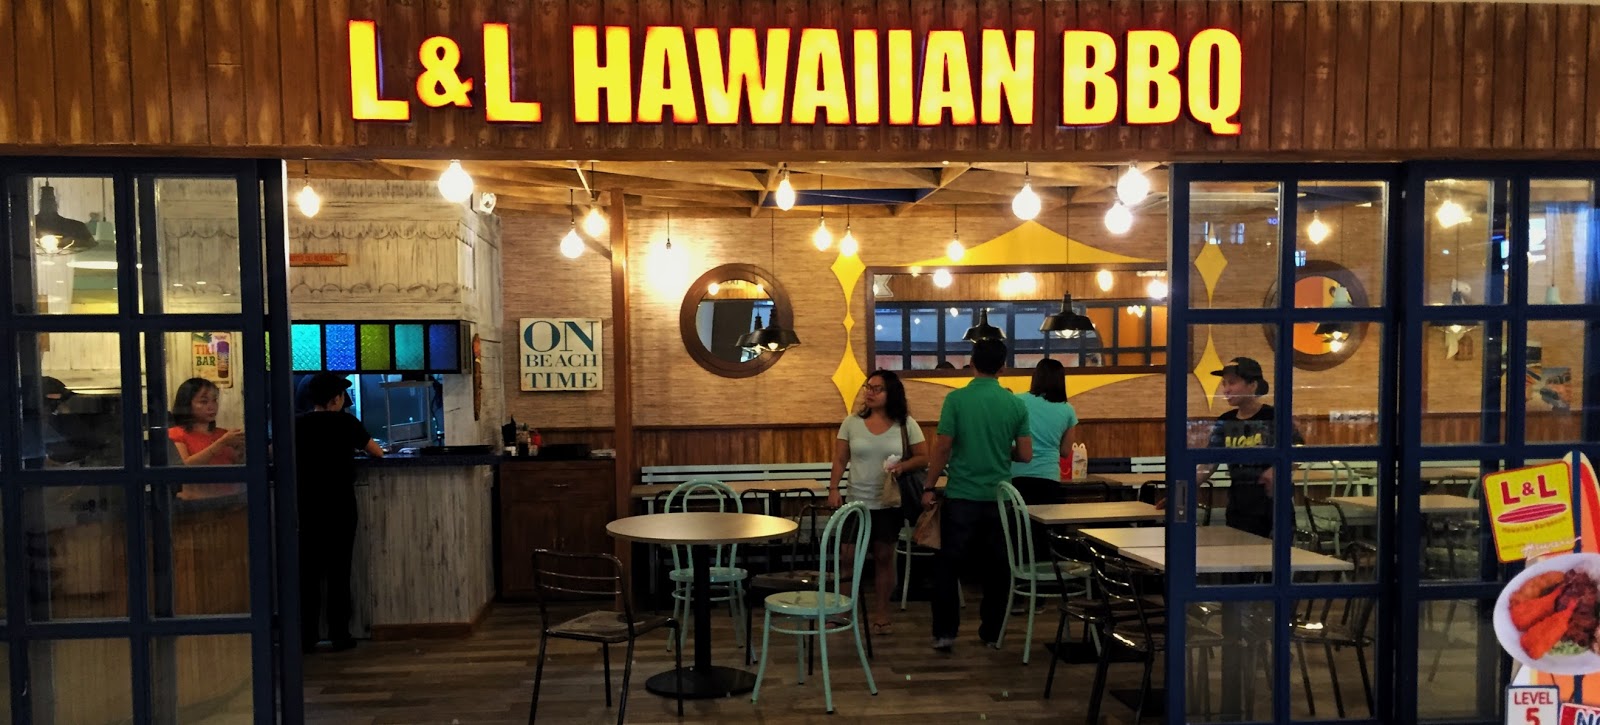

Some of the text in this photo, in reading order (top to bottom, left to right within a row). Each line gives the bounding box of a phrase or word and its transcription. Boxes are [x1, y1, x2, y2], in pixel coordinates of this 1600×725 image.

[572, 25, 1036, 126] HAWAIIAN
[1062, 28, 1243, 136] BBQ
[523, 320, 599, 353] ON
[195, 355, 216, 367] BAR
[525, 353, 599, 368] BEACH
[524, 372, 598, 389] TIME
[1500, 474, 1557, 505] L&L
[1513, 691, 1554, 705] LEVEL
[1525, 707, 1541, 725] 5
